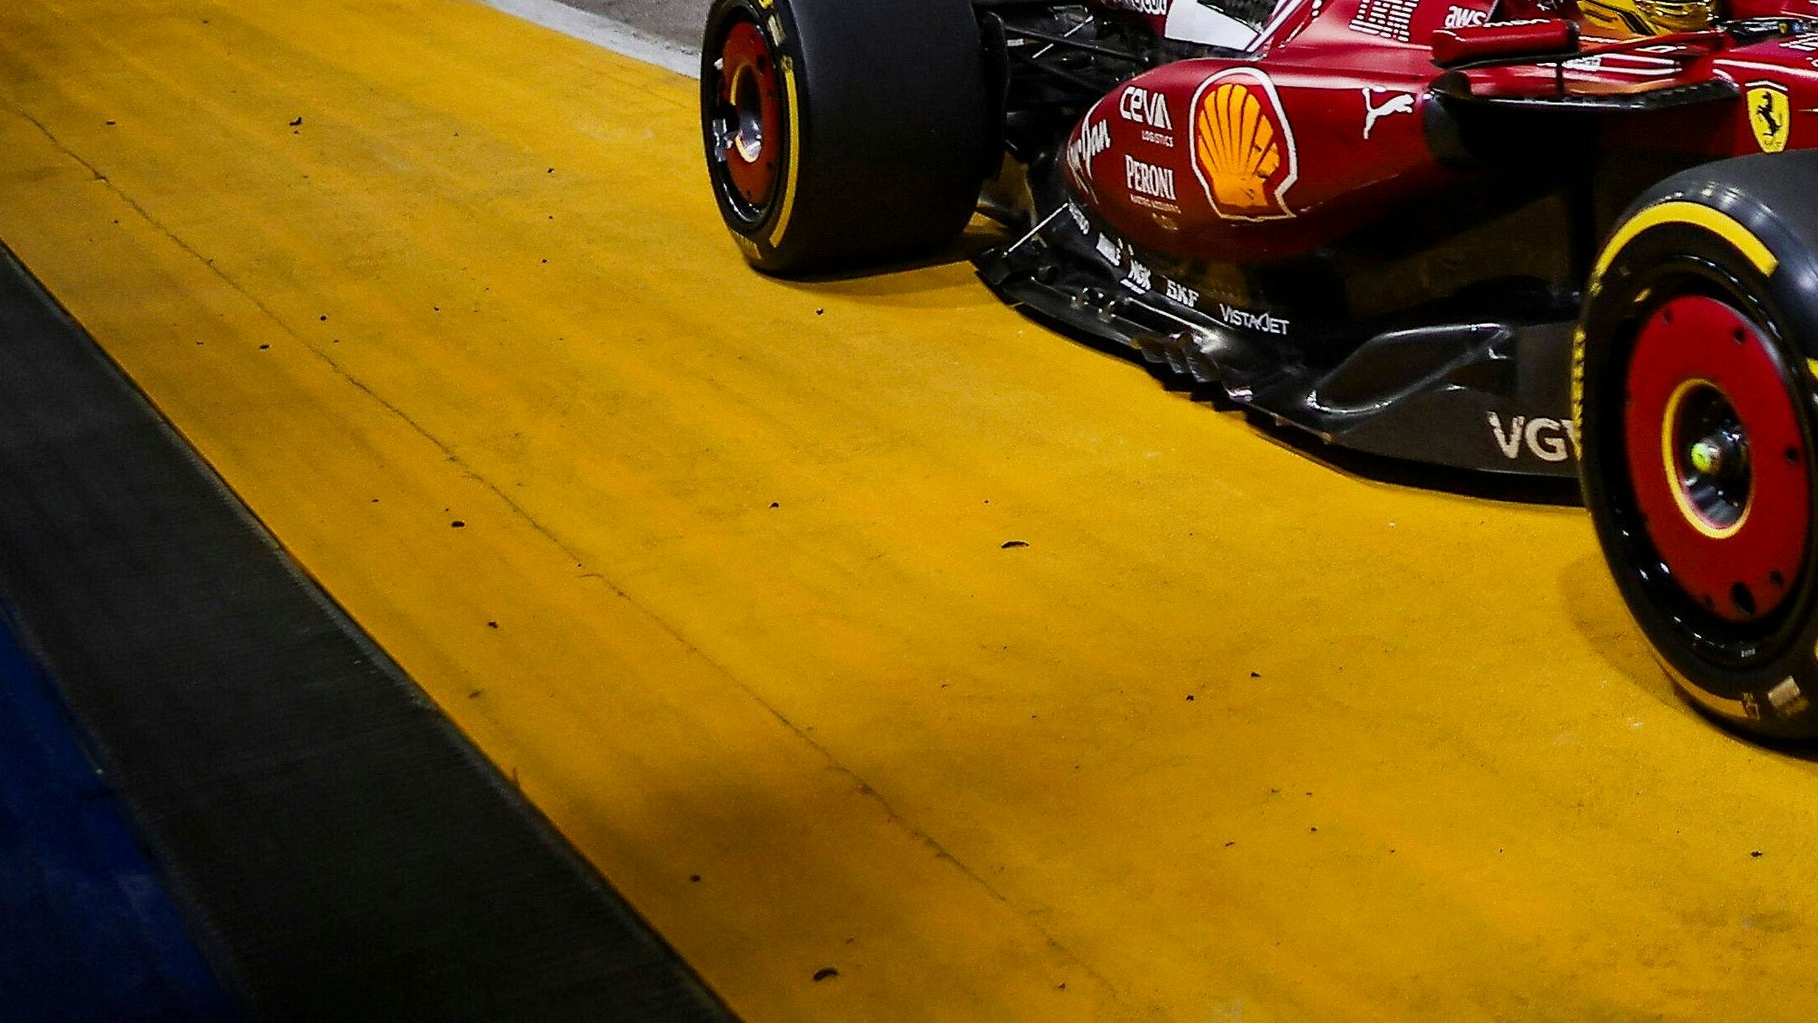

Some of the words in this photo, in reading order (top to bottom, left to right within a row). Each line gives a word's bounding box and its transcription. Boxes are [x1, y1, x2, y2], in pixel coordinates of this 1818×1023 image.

[1444, 5, 1487, 28] aws
[1125, 154, 1177, 191] PERONI
[1166, 279, 1200, 308] SKF
